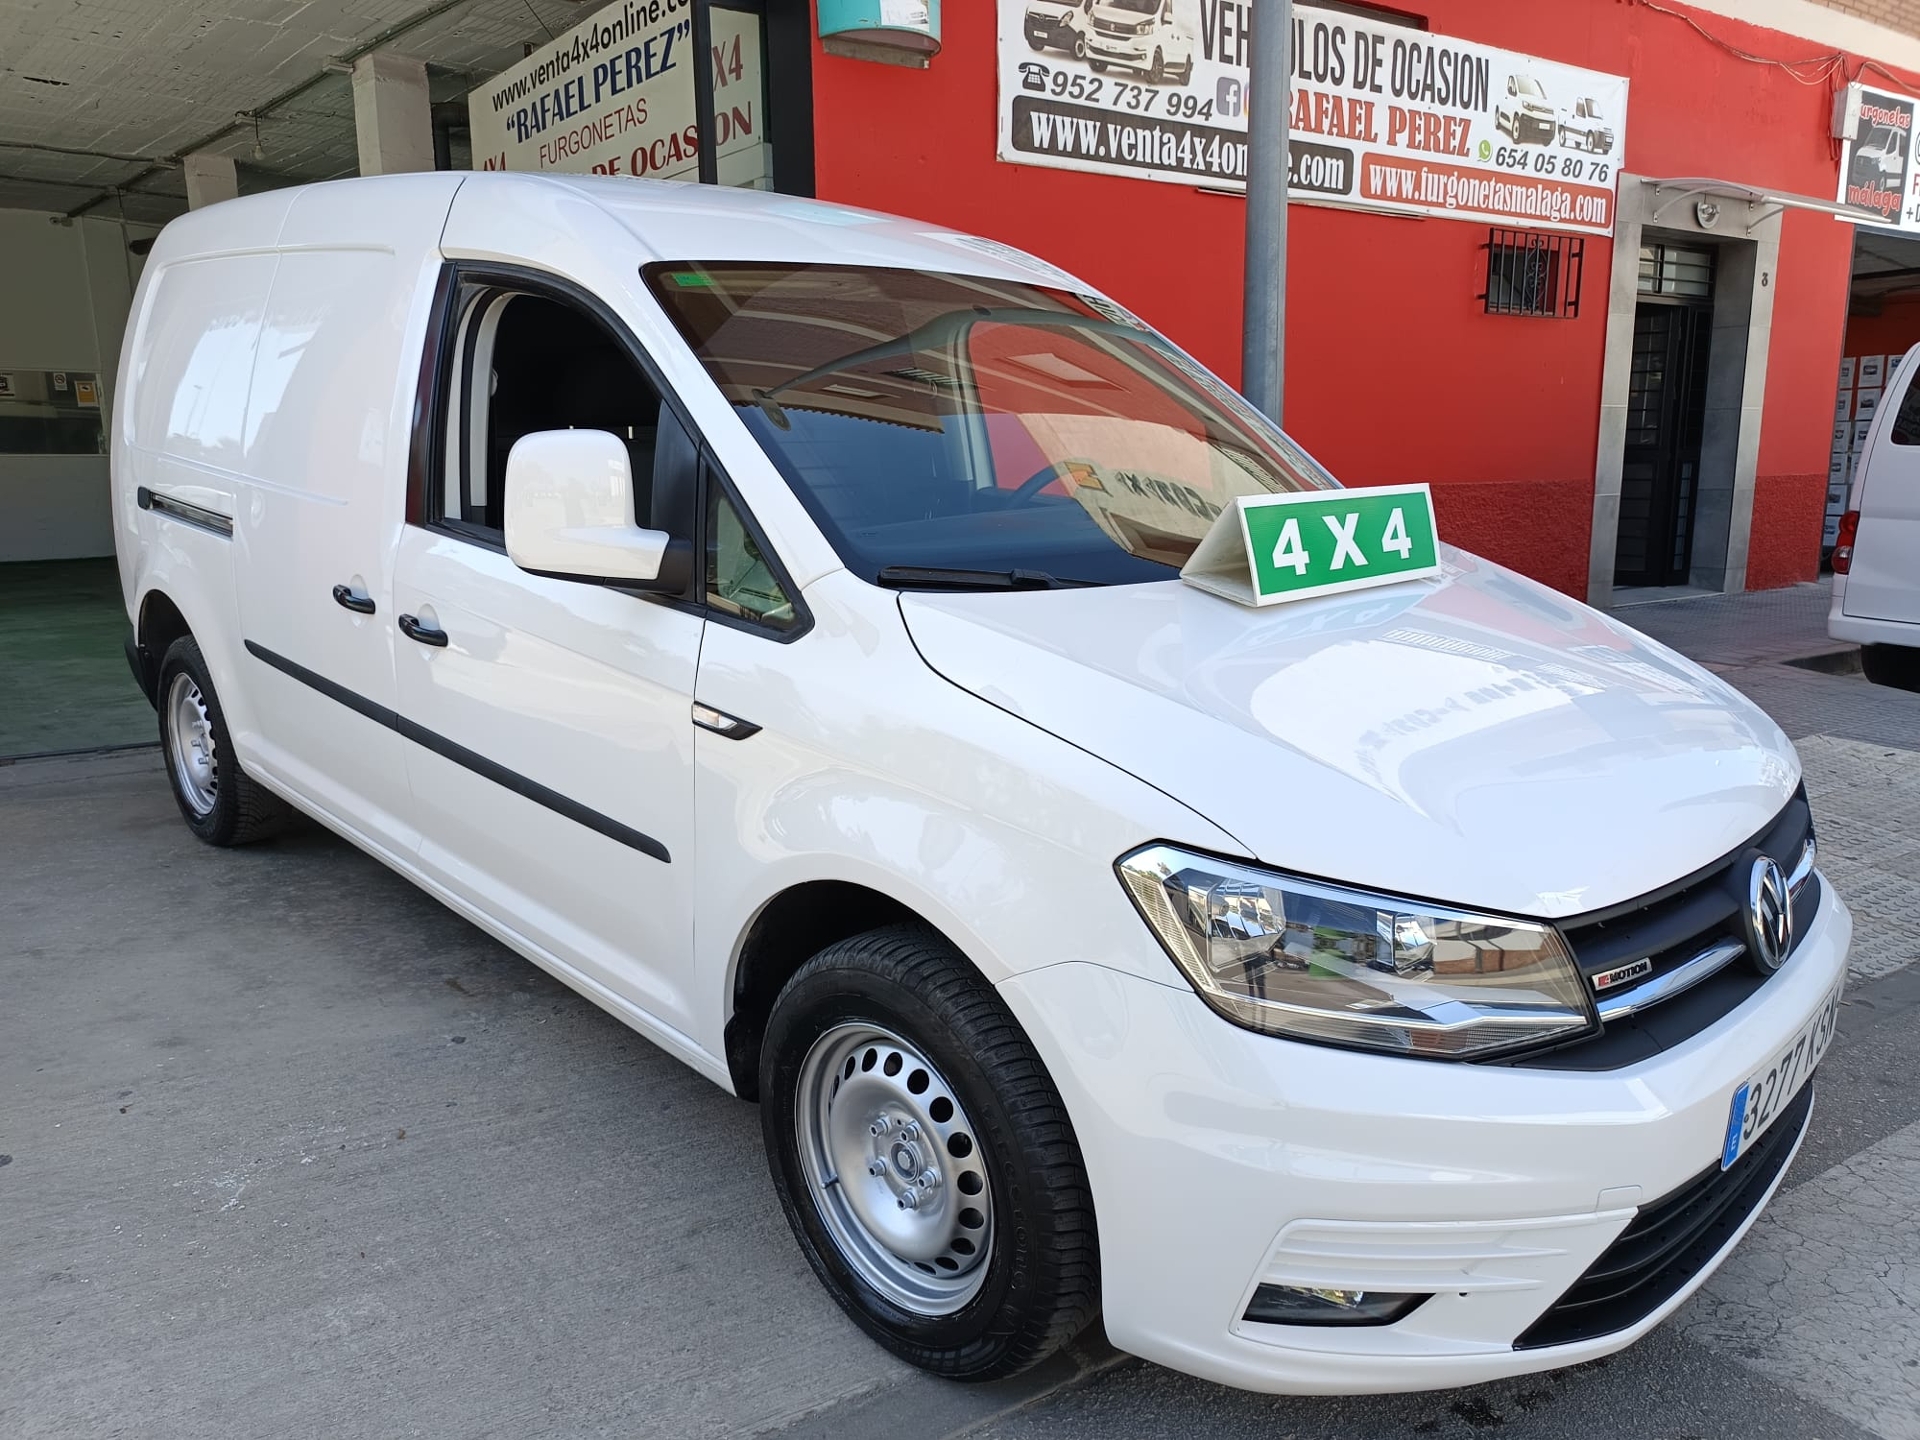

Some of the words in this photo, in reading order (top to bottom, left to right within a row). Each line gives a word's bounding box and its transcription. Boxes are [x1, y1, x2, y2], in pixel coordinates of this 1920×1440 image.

[492, 0, 690, 112] www.venta4x4online.c
[1200, 0, 1346, 86] VEHLOS
[1353, 30, 1385, 94] DE
[1390, 38, 1490, 113] OCASION
[1050, 69, 1104, 104] 952
[1111, 81, 1159, 113] 737
[1166, 92, 1215, 122] 994
[1860, 104, 1911, 129] urgonetas
[539, 97, 648, 169] FURGONETAS
[1030, 111, 1345, 190] www.venta4x4on.com
[1386, 104, 1473, 157] PEREZ
[1368, 163, 1607, 224] www.furgonetasmalaga.com
[1495, 146, 1528, 171] 654
[1534, 152, 1556, 174] 05
[1561, 156, 1584, 179] 80
[1587, 161, 1610, 183] 76
[1761, 272, 1769, 287] 3
[1743, 1035, 1806, 1141] 3277
